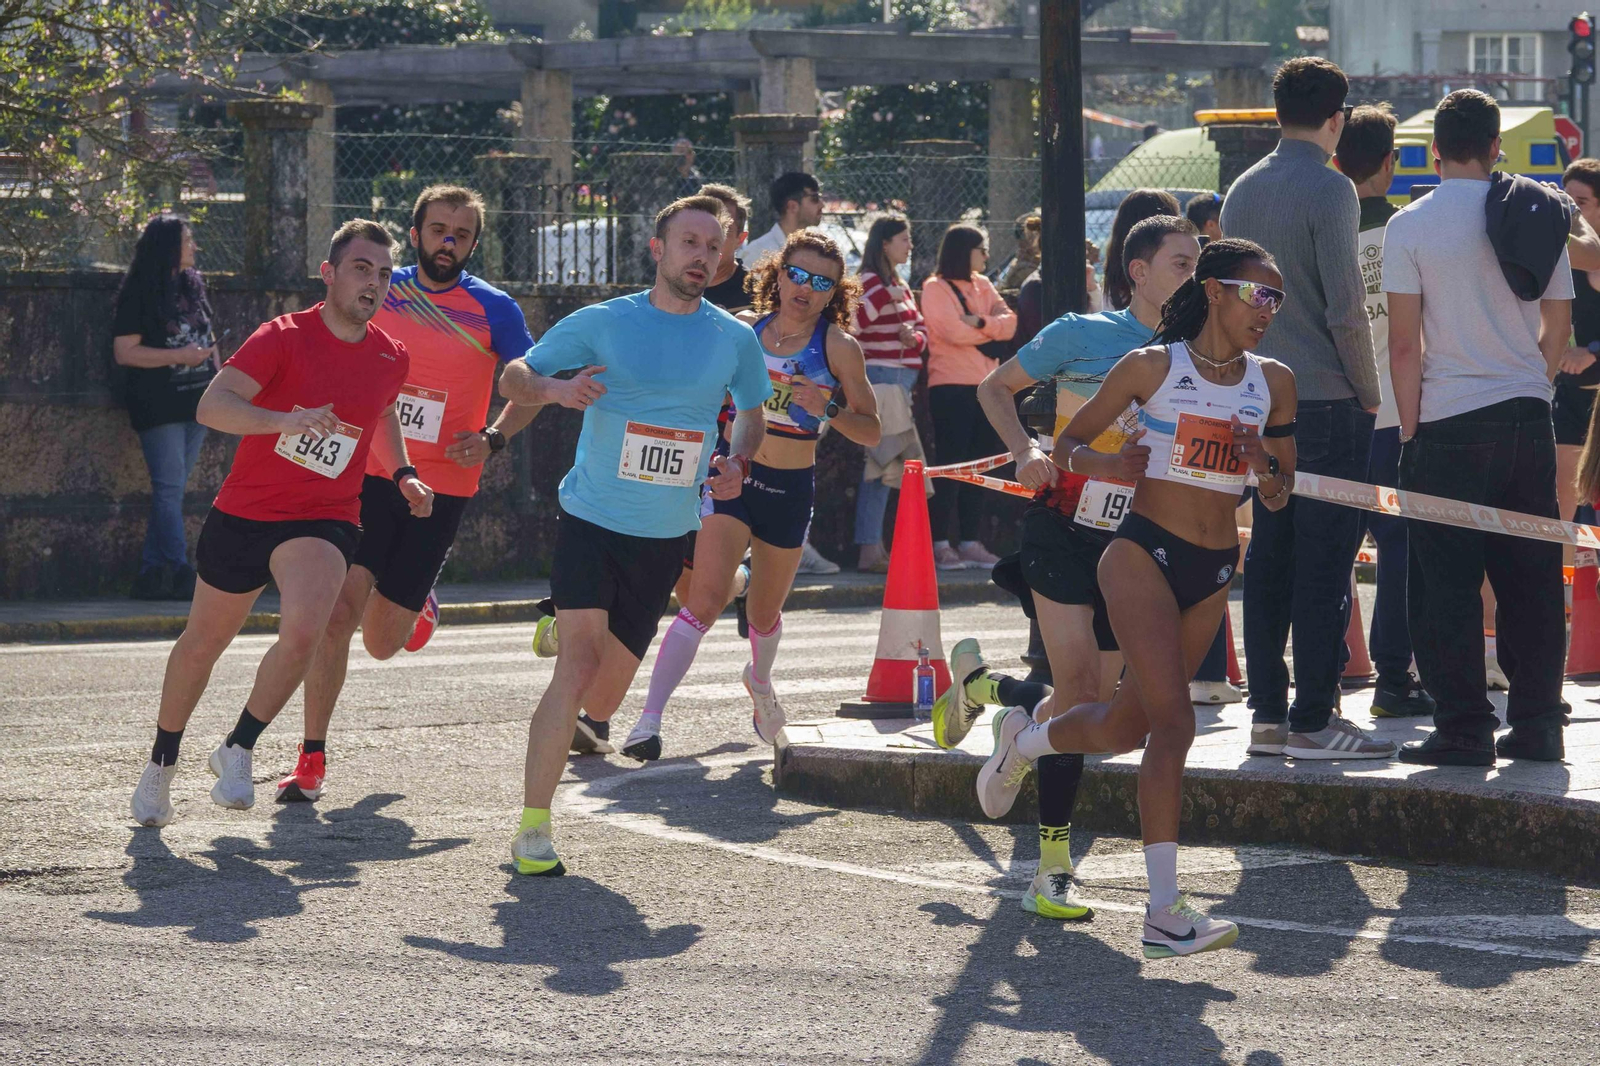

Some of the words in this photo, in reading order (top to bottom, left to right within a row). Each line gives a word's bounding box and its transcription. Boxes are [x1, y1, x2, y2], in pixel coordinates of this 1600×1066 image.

[764, 388, 791, 414] 34
[295, 434, 342, 467] 943
[640, 445, 685, 475] 1015
[1187, 437, 1240, 473] 2018
